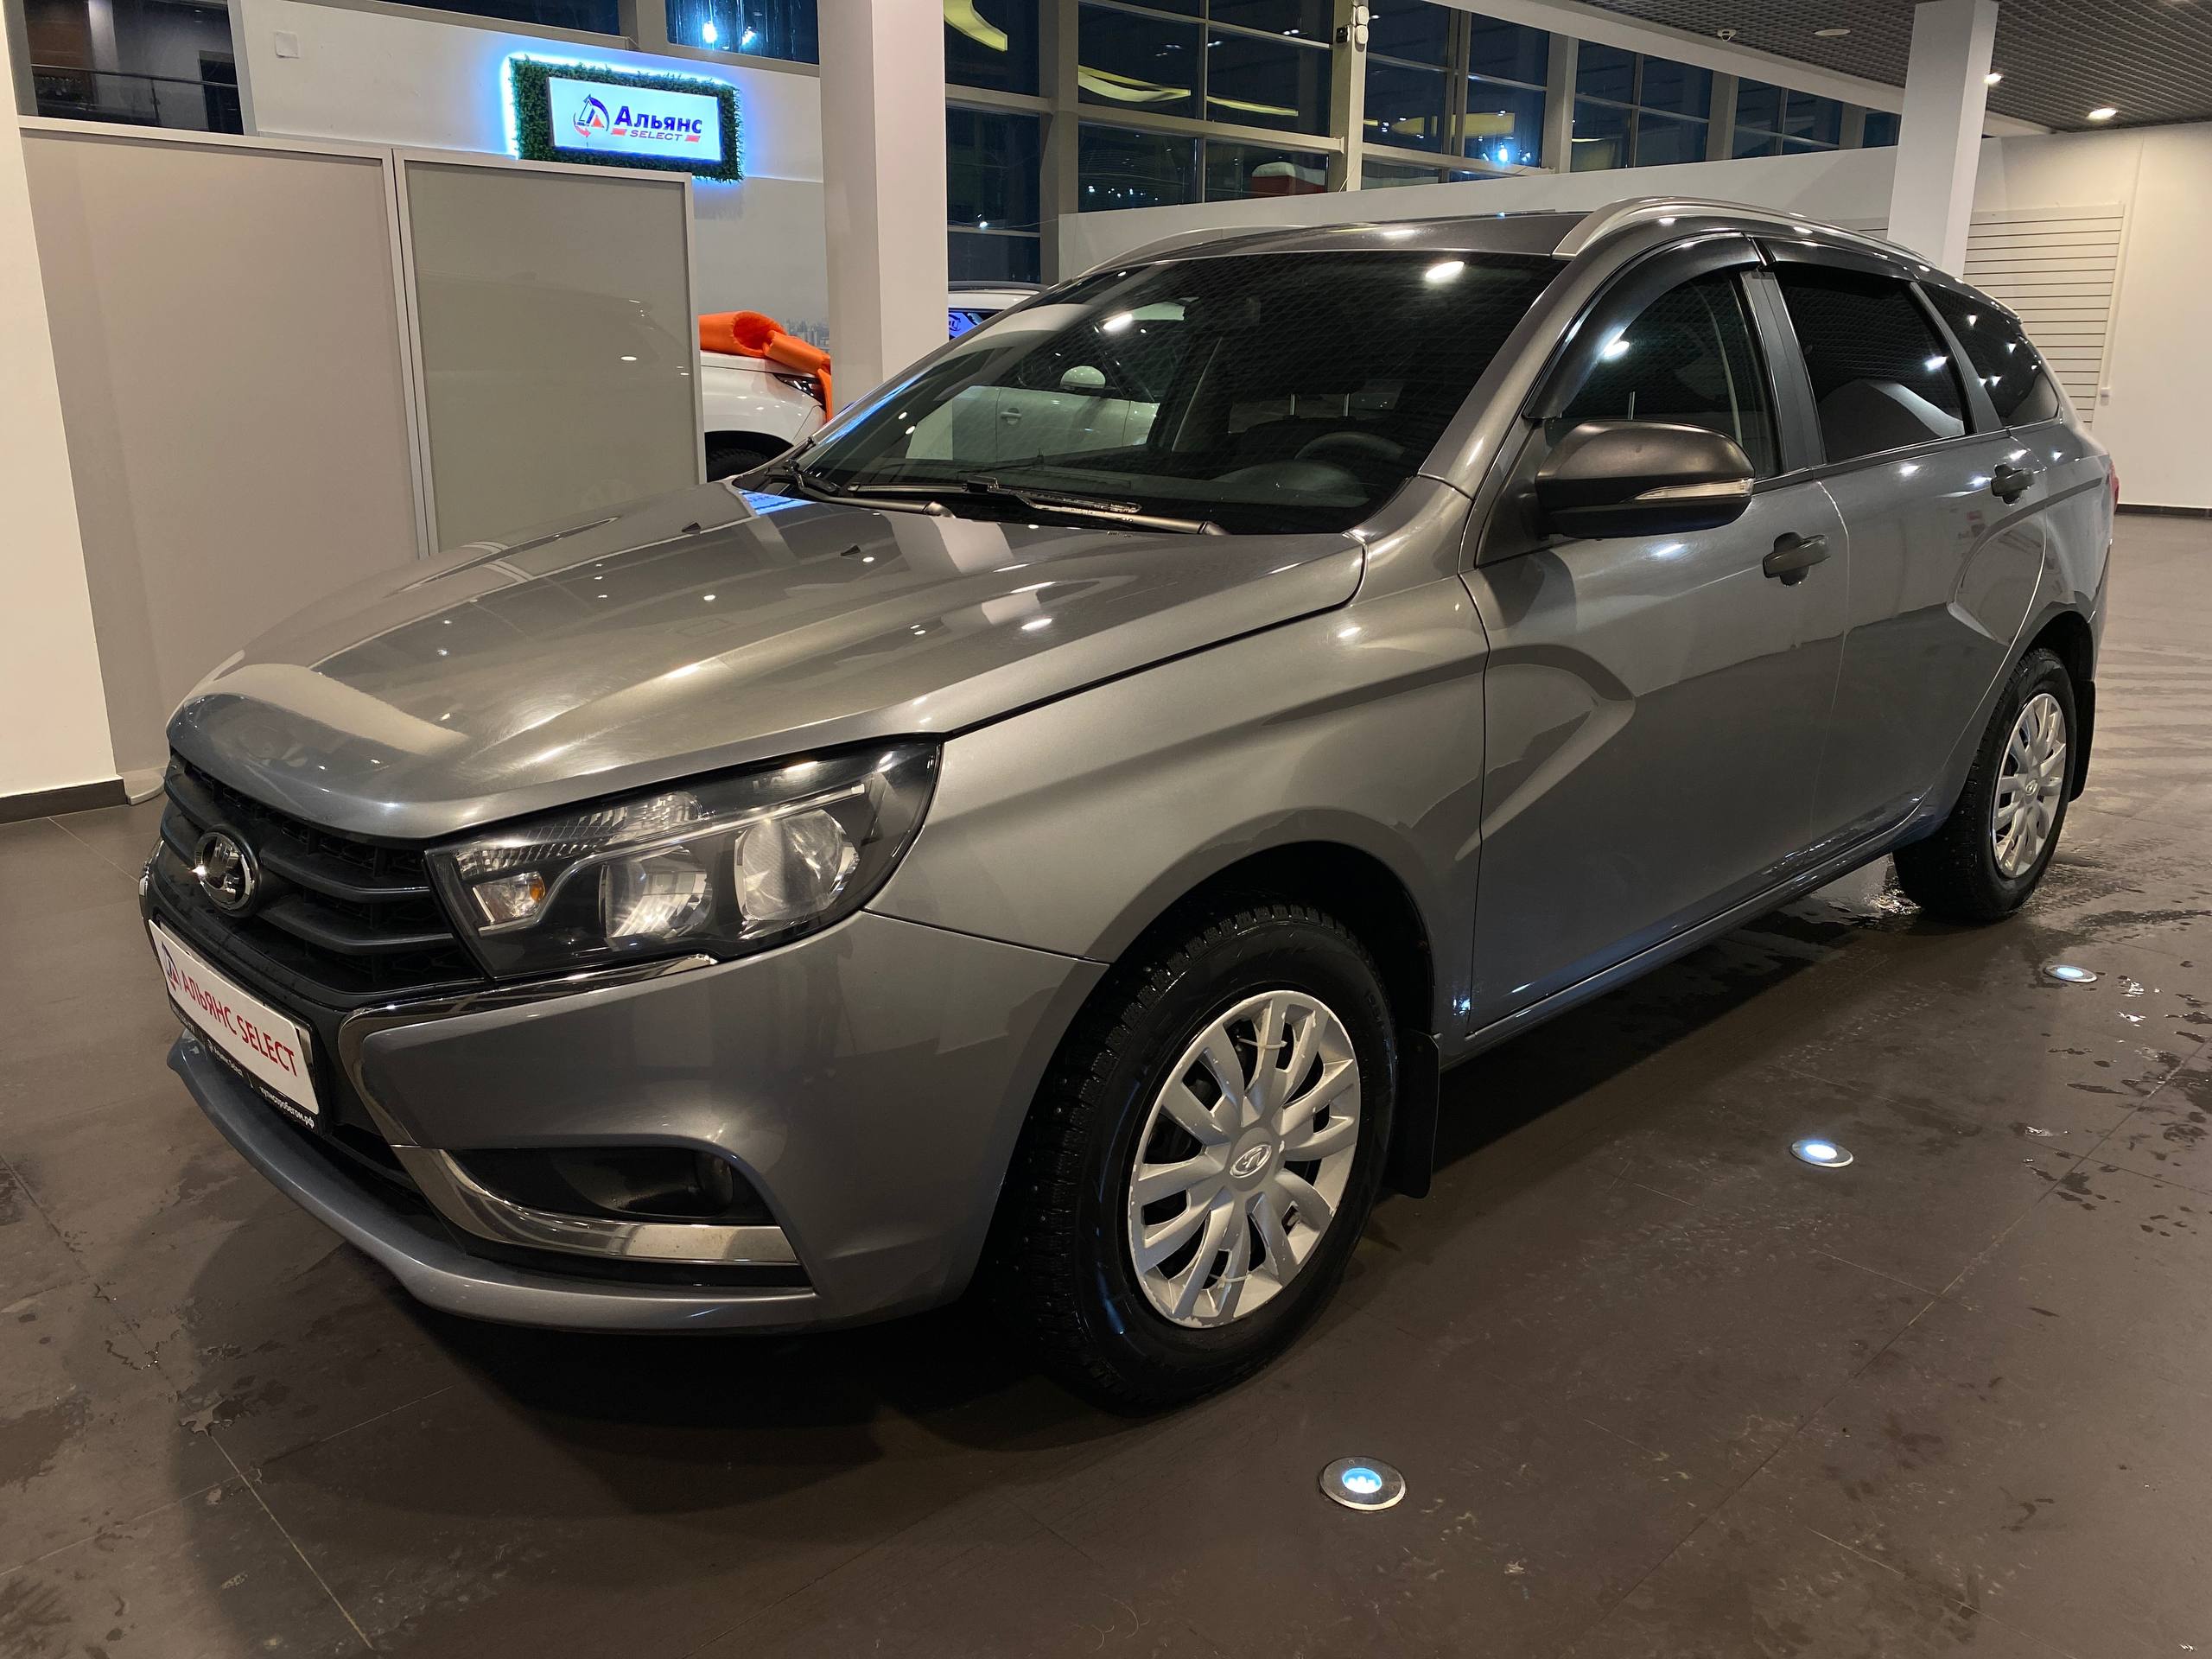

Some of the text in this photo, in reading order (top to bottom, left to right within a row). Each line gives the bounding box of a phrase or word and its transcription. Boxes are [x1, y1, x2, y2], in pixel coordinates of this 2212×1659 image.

[614, 105, 702, 134] Альянс
[630, 129, 683, 142] SELECT
[181, 969, 238, 1035] АЛЬЯНС
[236, 1014, 298, 1077] SELECT
